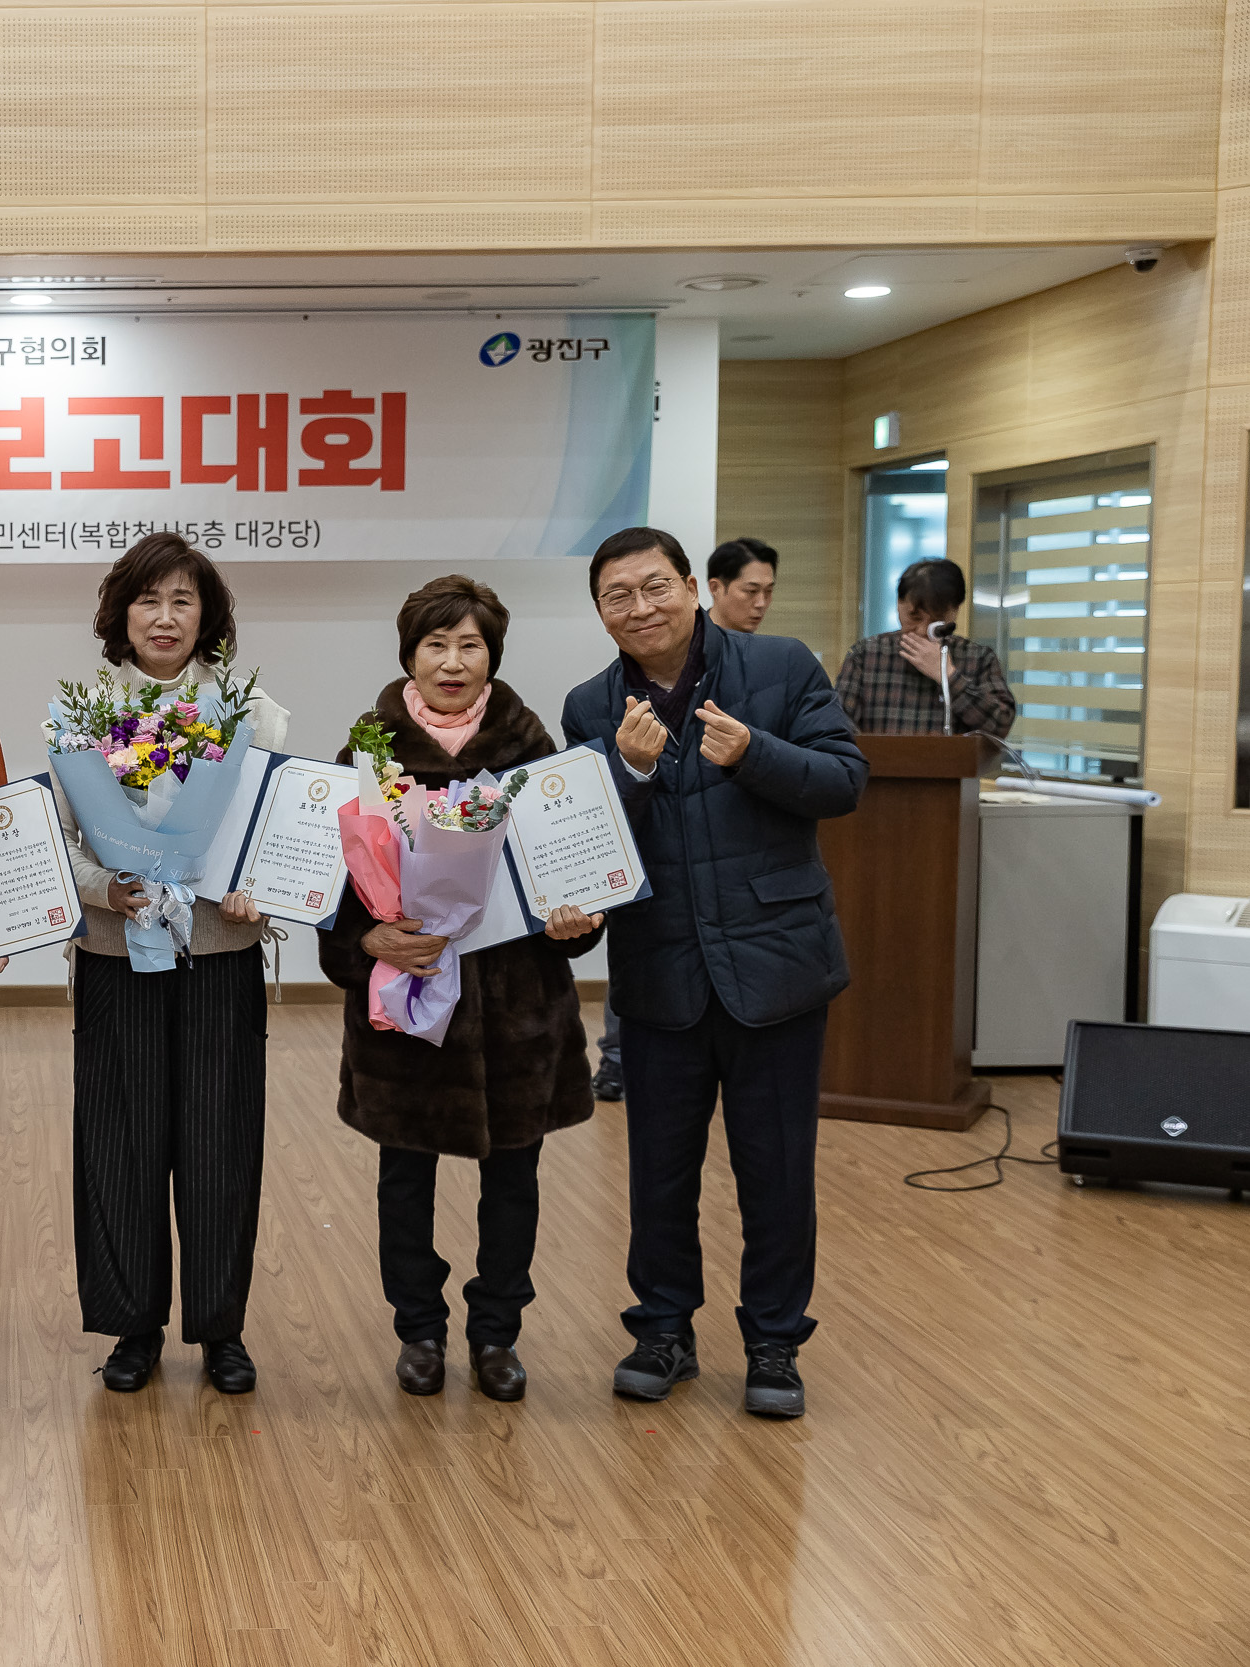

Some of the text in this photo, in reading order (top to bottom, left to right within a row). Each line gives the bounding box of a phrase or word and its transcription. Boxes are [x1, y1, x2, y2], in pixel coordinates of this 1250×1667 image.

[526, 338, 610, 363] 광진구
[235, 519, 321, 549] 대강당)
[93, 825, 107, 840] You
